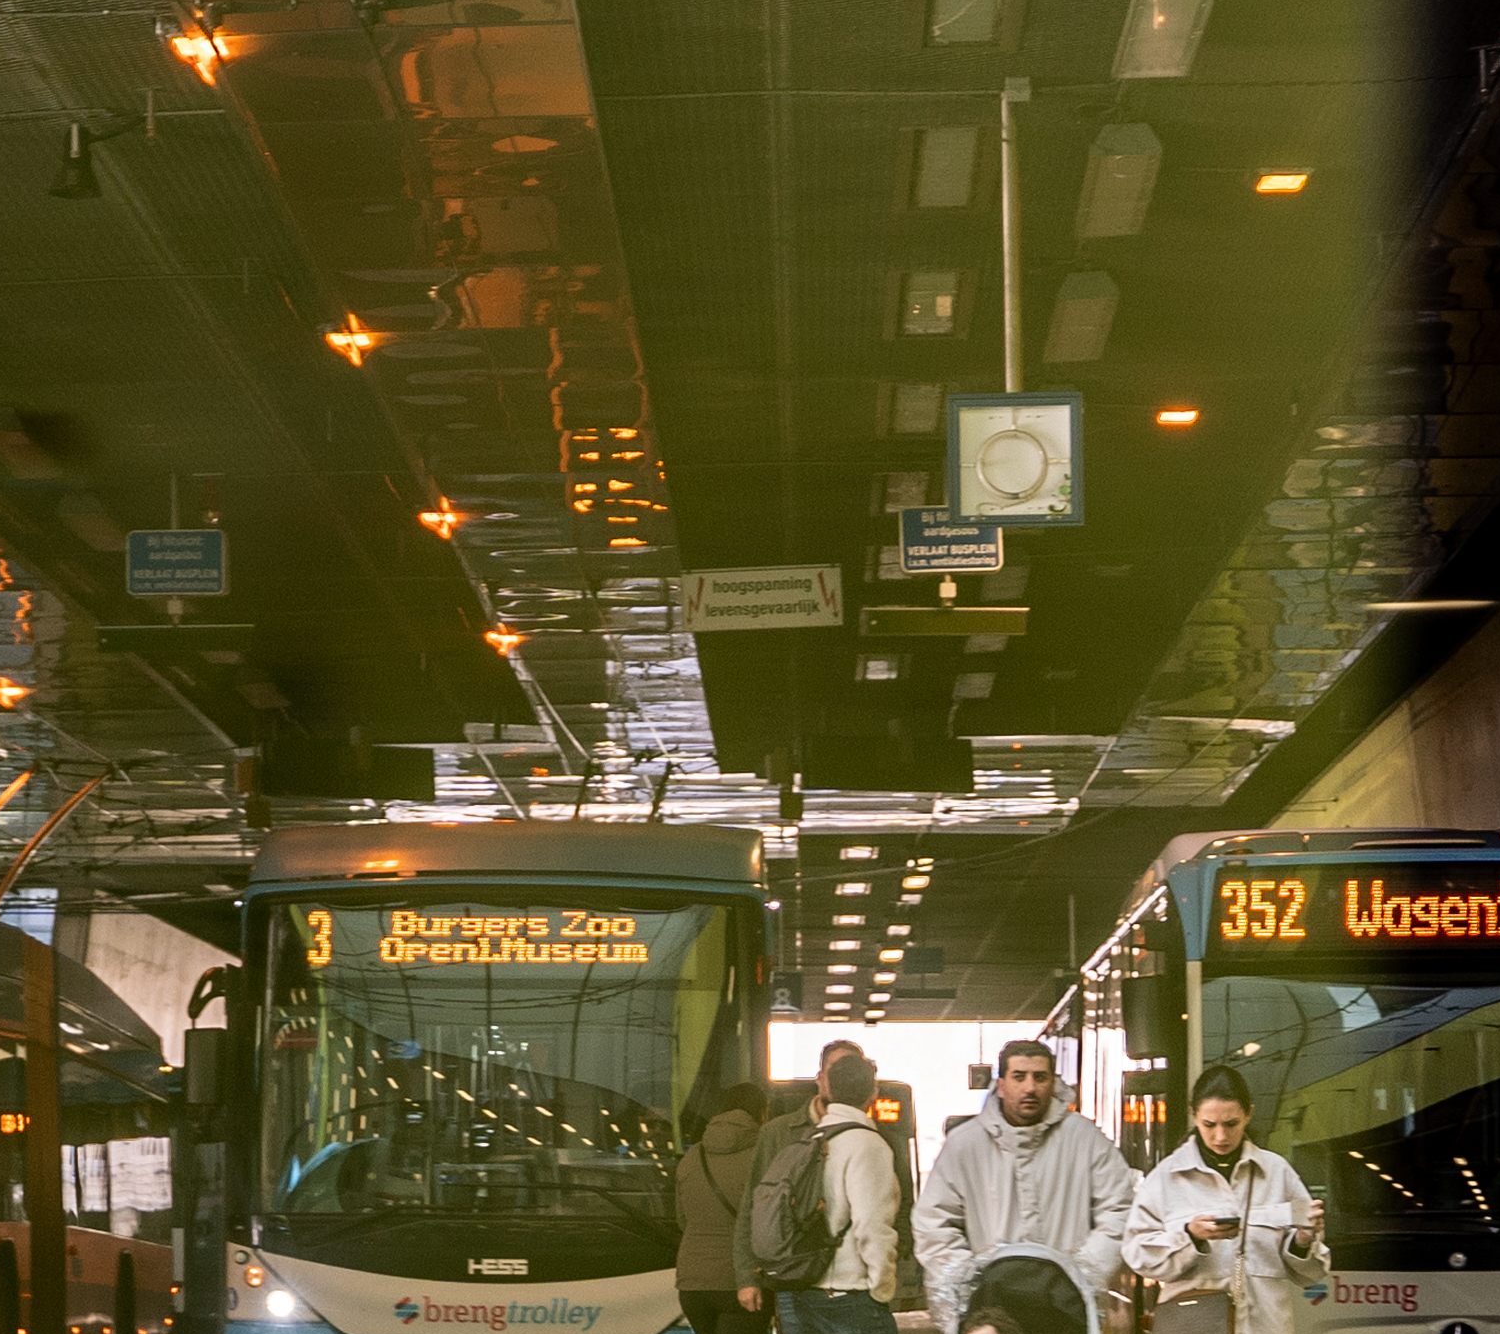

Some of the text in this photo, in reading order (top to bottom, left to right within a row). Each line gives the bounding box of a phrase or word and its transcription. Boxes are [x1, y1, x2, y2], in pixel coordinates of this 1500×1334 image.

[907, 544, 997, 556] VERLAAT BUSPLEIN
[712, 577, 812, 595] hoogspanning
[705, 600, 820, 619] levensgevaarlijk
[1220, 879, 1307, 939] 352
[307, 910, 333, 966] 3
[391, 910, 637, 938] Burgers Zoo
[468, 1259, 529, 1275] HESS
[1333, 1276, 1419, 1312] breng
[424, 1294, 602, 1332] brengtrolley
